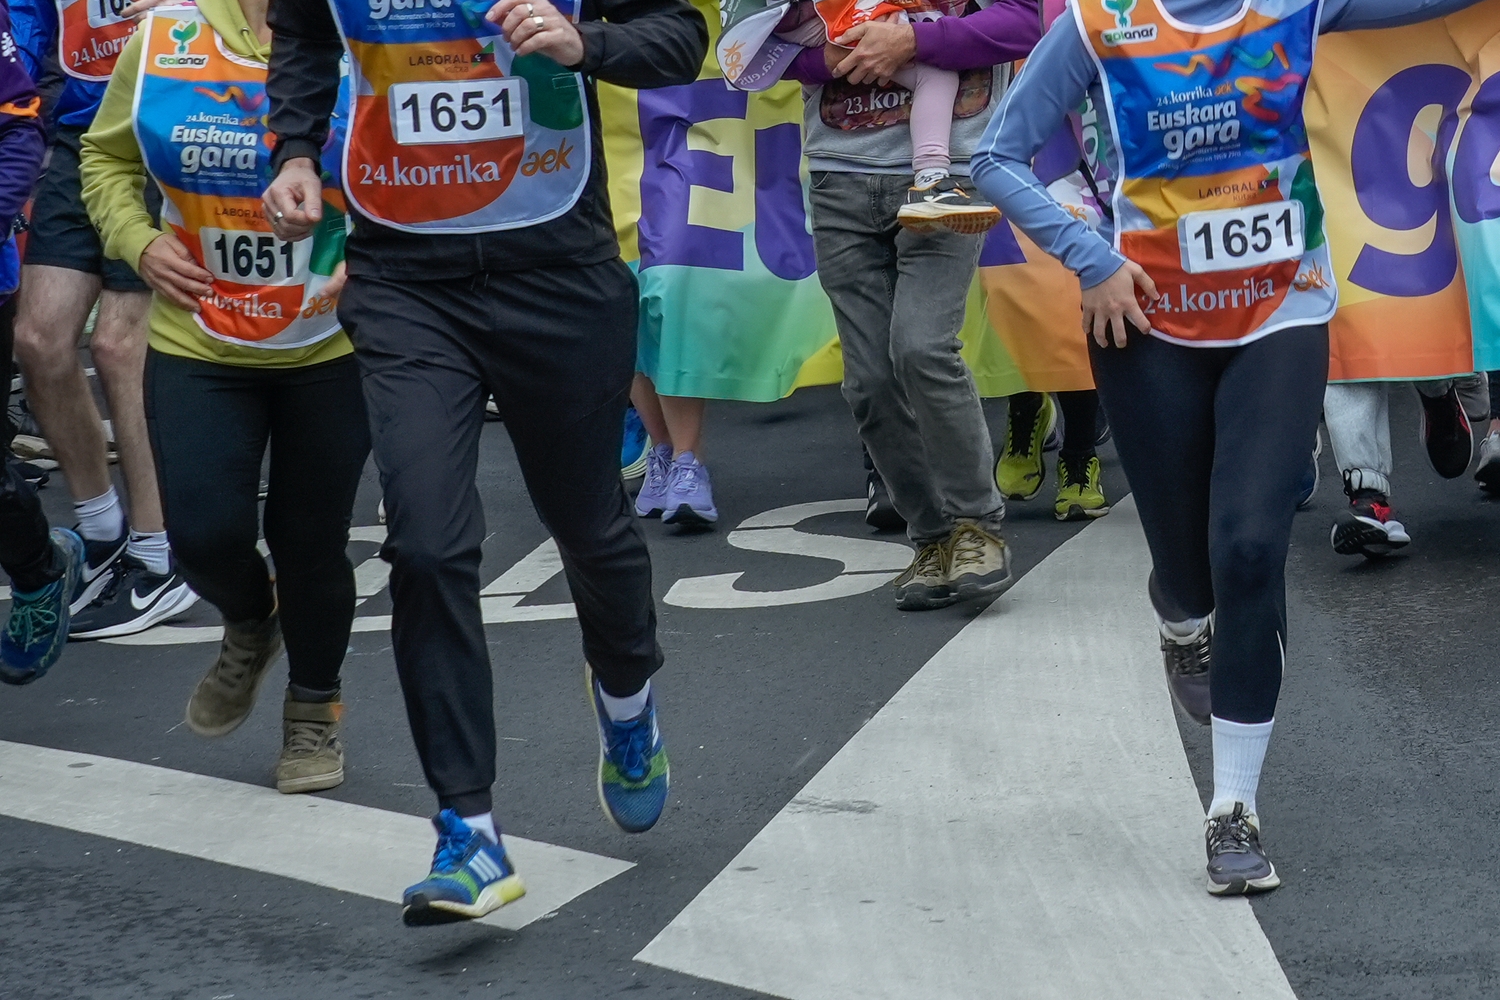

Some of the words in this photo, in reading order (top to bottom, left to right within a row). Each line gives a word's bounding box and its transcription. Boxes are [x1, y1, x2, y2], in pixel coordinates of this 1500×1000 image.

[409, 54, 469, 66] LABORAL
[401, 88, 513, 133] 1651
[1156, 84, 1212, 107] 24.korrika
[185, 112, 239, 126] 24.korrika
[1147, 100, 1237, 131] Euskara
[170, 125, 258, 147] Euskara
[1163, 119, 1241, 160] gara
[180, 144, 257, 174] gara
[358, 154, 502, 186] 24.korrika
[520, 137, 574, 177] aek
[1199, 181, 1256, 199] LABORAL
[214, 206, 264, 218] LABORAL
[1193, 208, 1294, 261] 1651
[214, 233, 294, 279] 1651
[1293, 257, 1331, 292] aek
[302, 295, 337, 319] ae
[1141, 277, 1275, 315] 24.korrika
